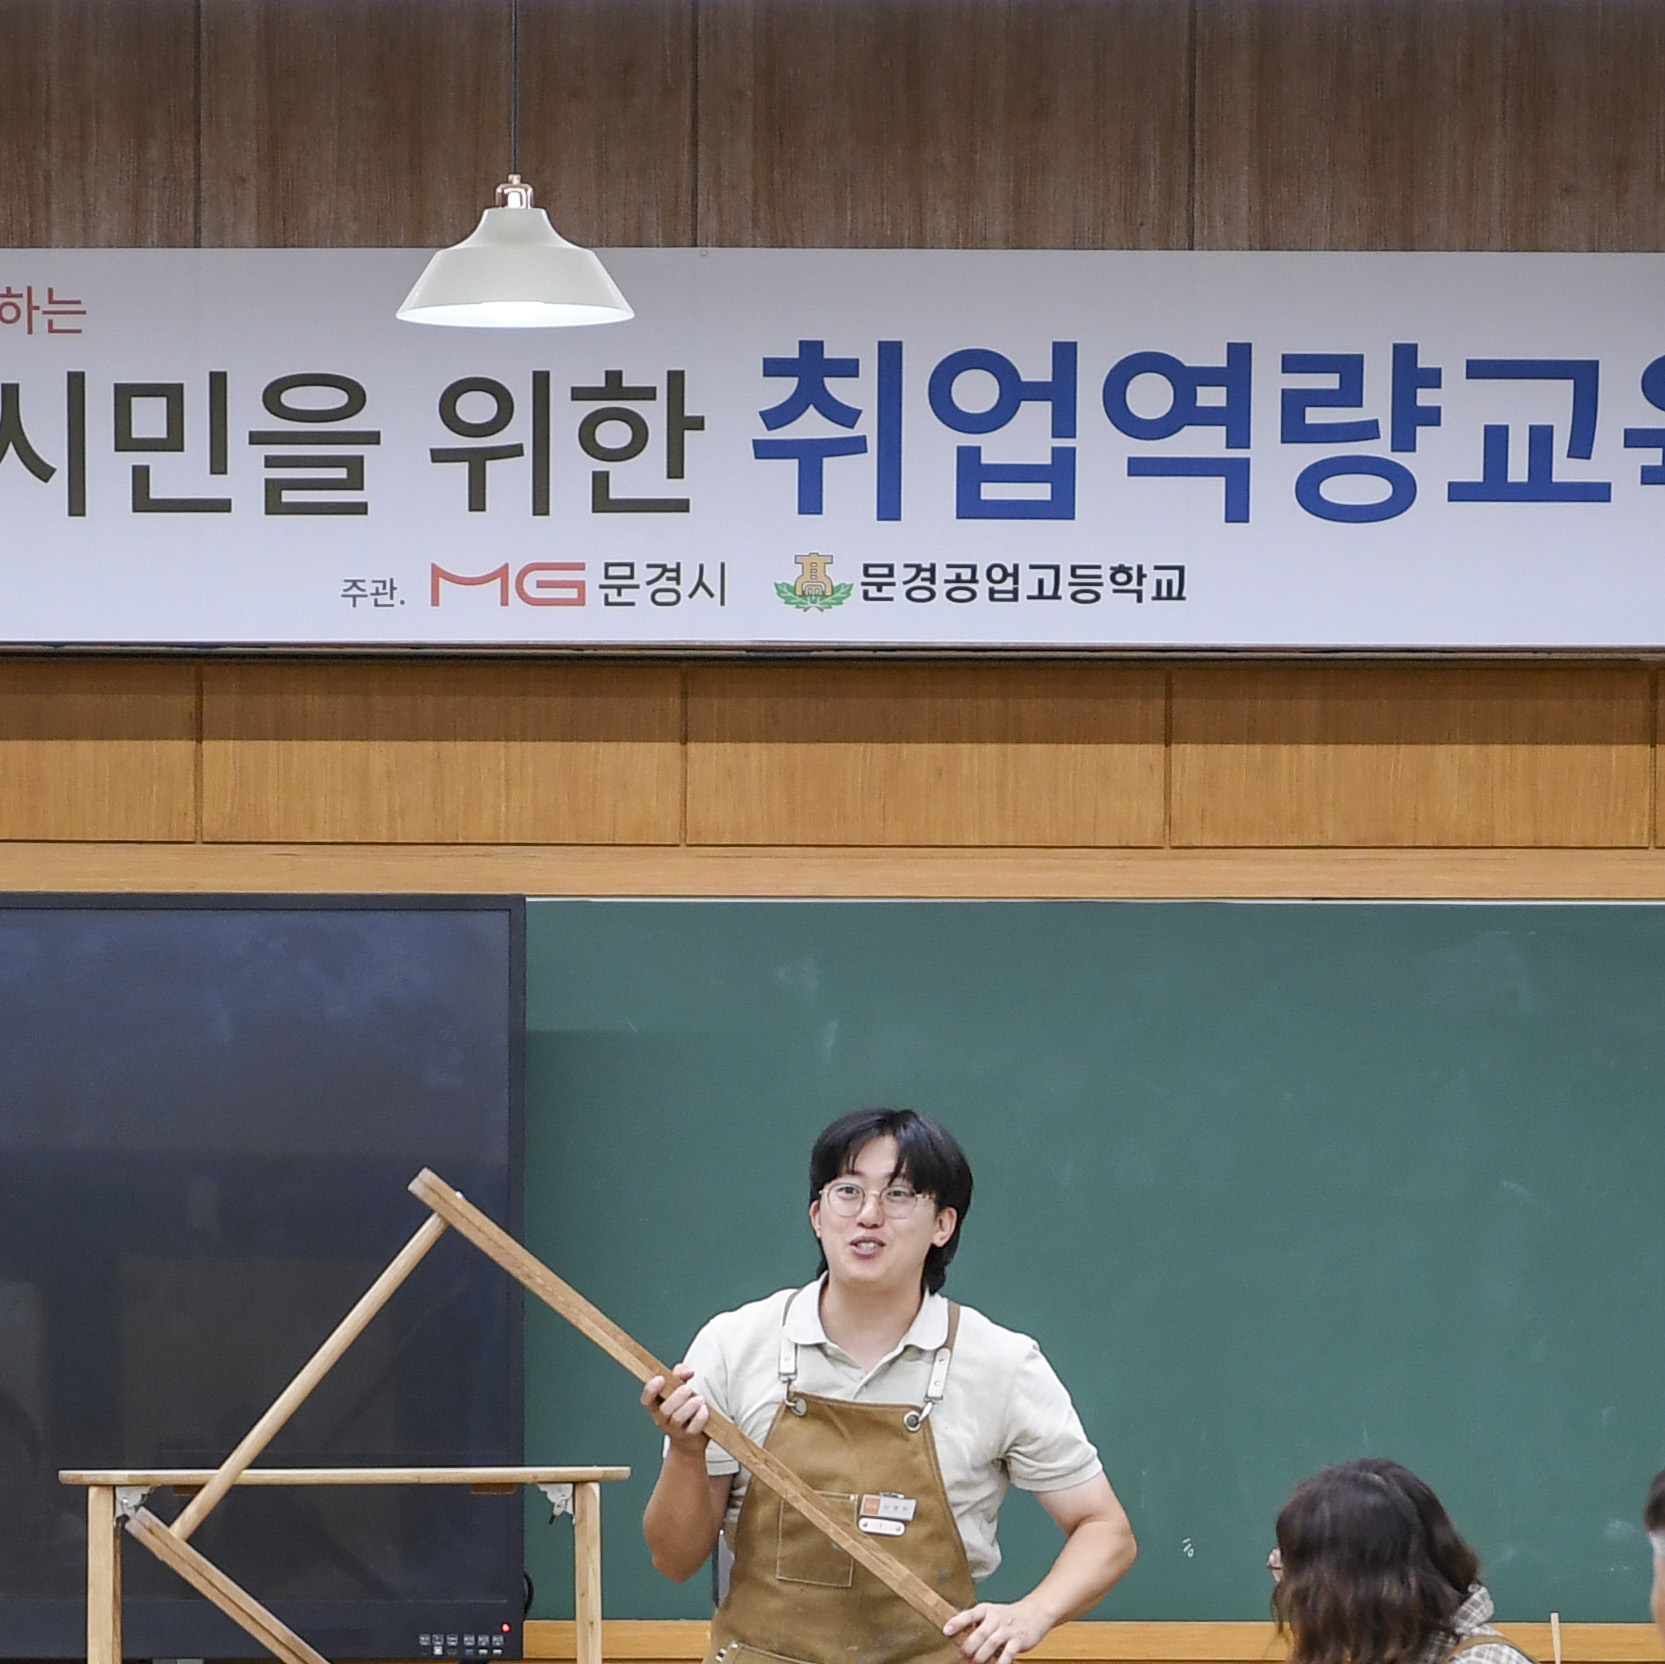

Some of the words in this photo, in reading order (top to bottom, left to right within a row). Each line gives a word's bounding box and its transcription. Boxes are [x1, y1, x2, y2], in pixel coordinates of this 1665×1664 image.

[429, 369, 706, 517] 위한
[340, 577, 406, 609] 주관.
[430, 561, 586, 607] MG
[598, 561, 726, 607] 문경시
[860, 562, 1187, 605] 문경공업고등학교
